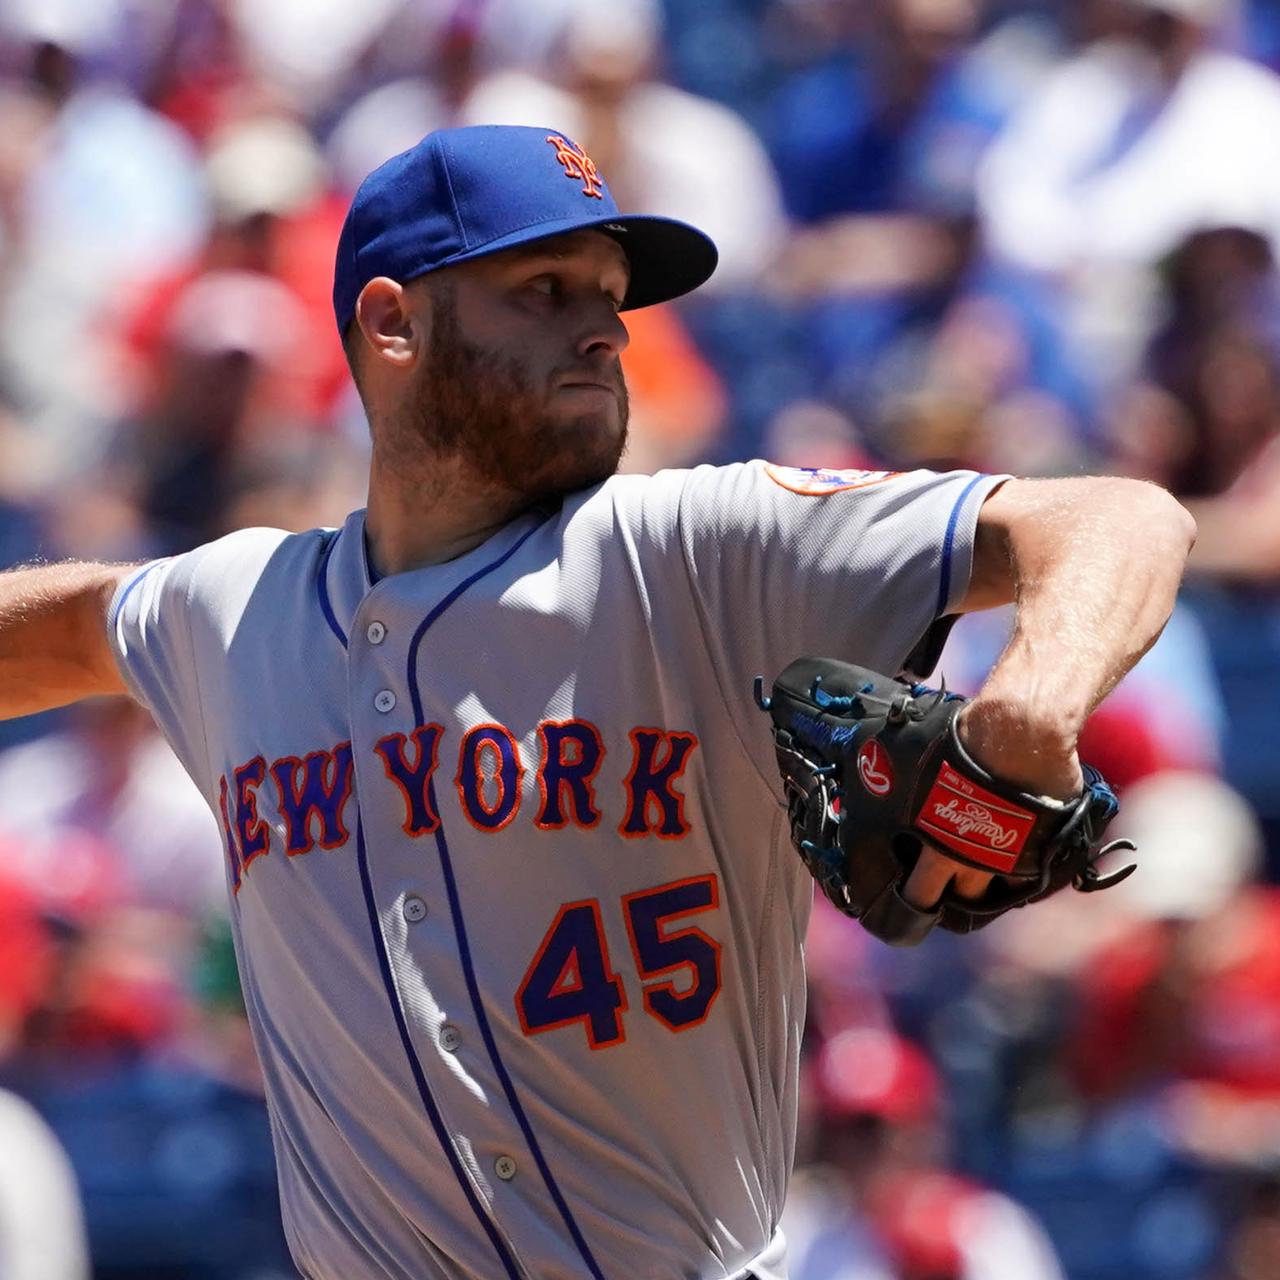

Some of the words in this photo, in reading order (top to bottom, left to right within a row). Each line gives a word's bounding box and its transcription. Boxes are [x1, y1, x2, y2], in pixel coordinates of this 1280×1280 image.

[220, 741, 352, 897] EW
[373, 719, 699, 840] YORK
[933, 799, 1019, 850] Rawlings
[514, 872, 722, 1051] 45
